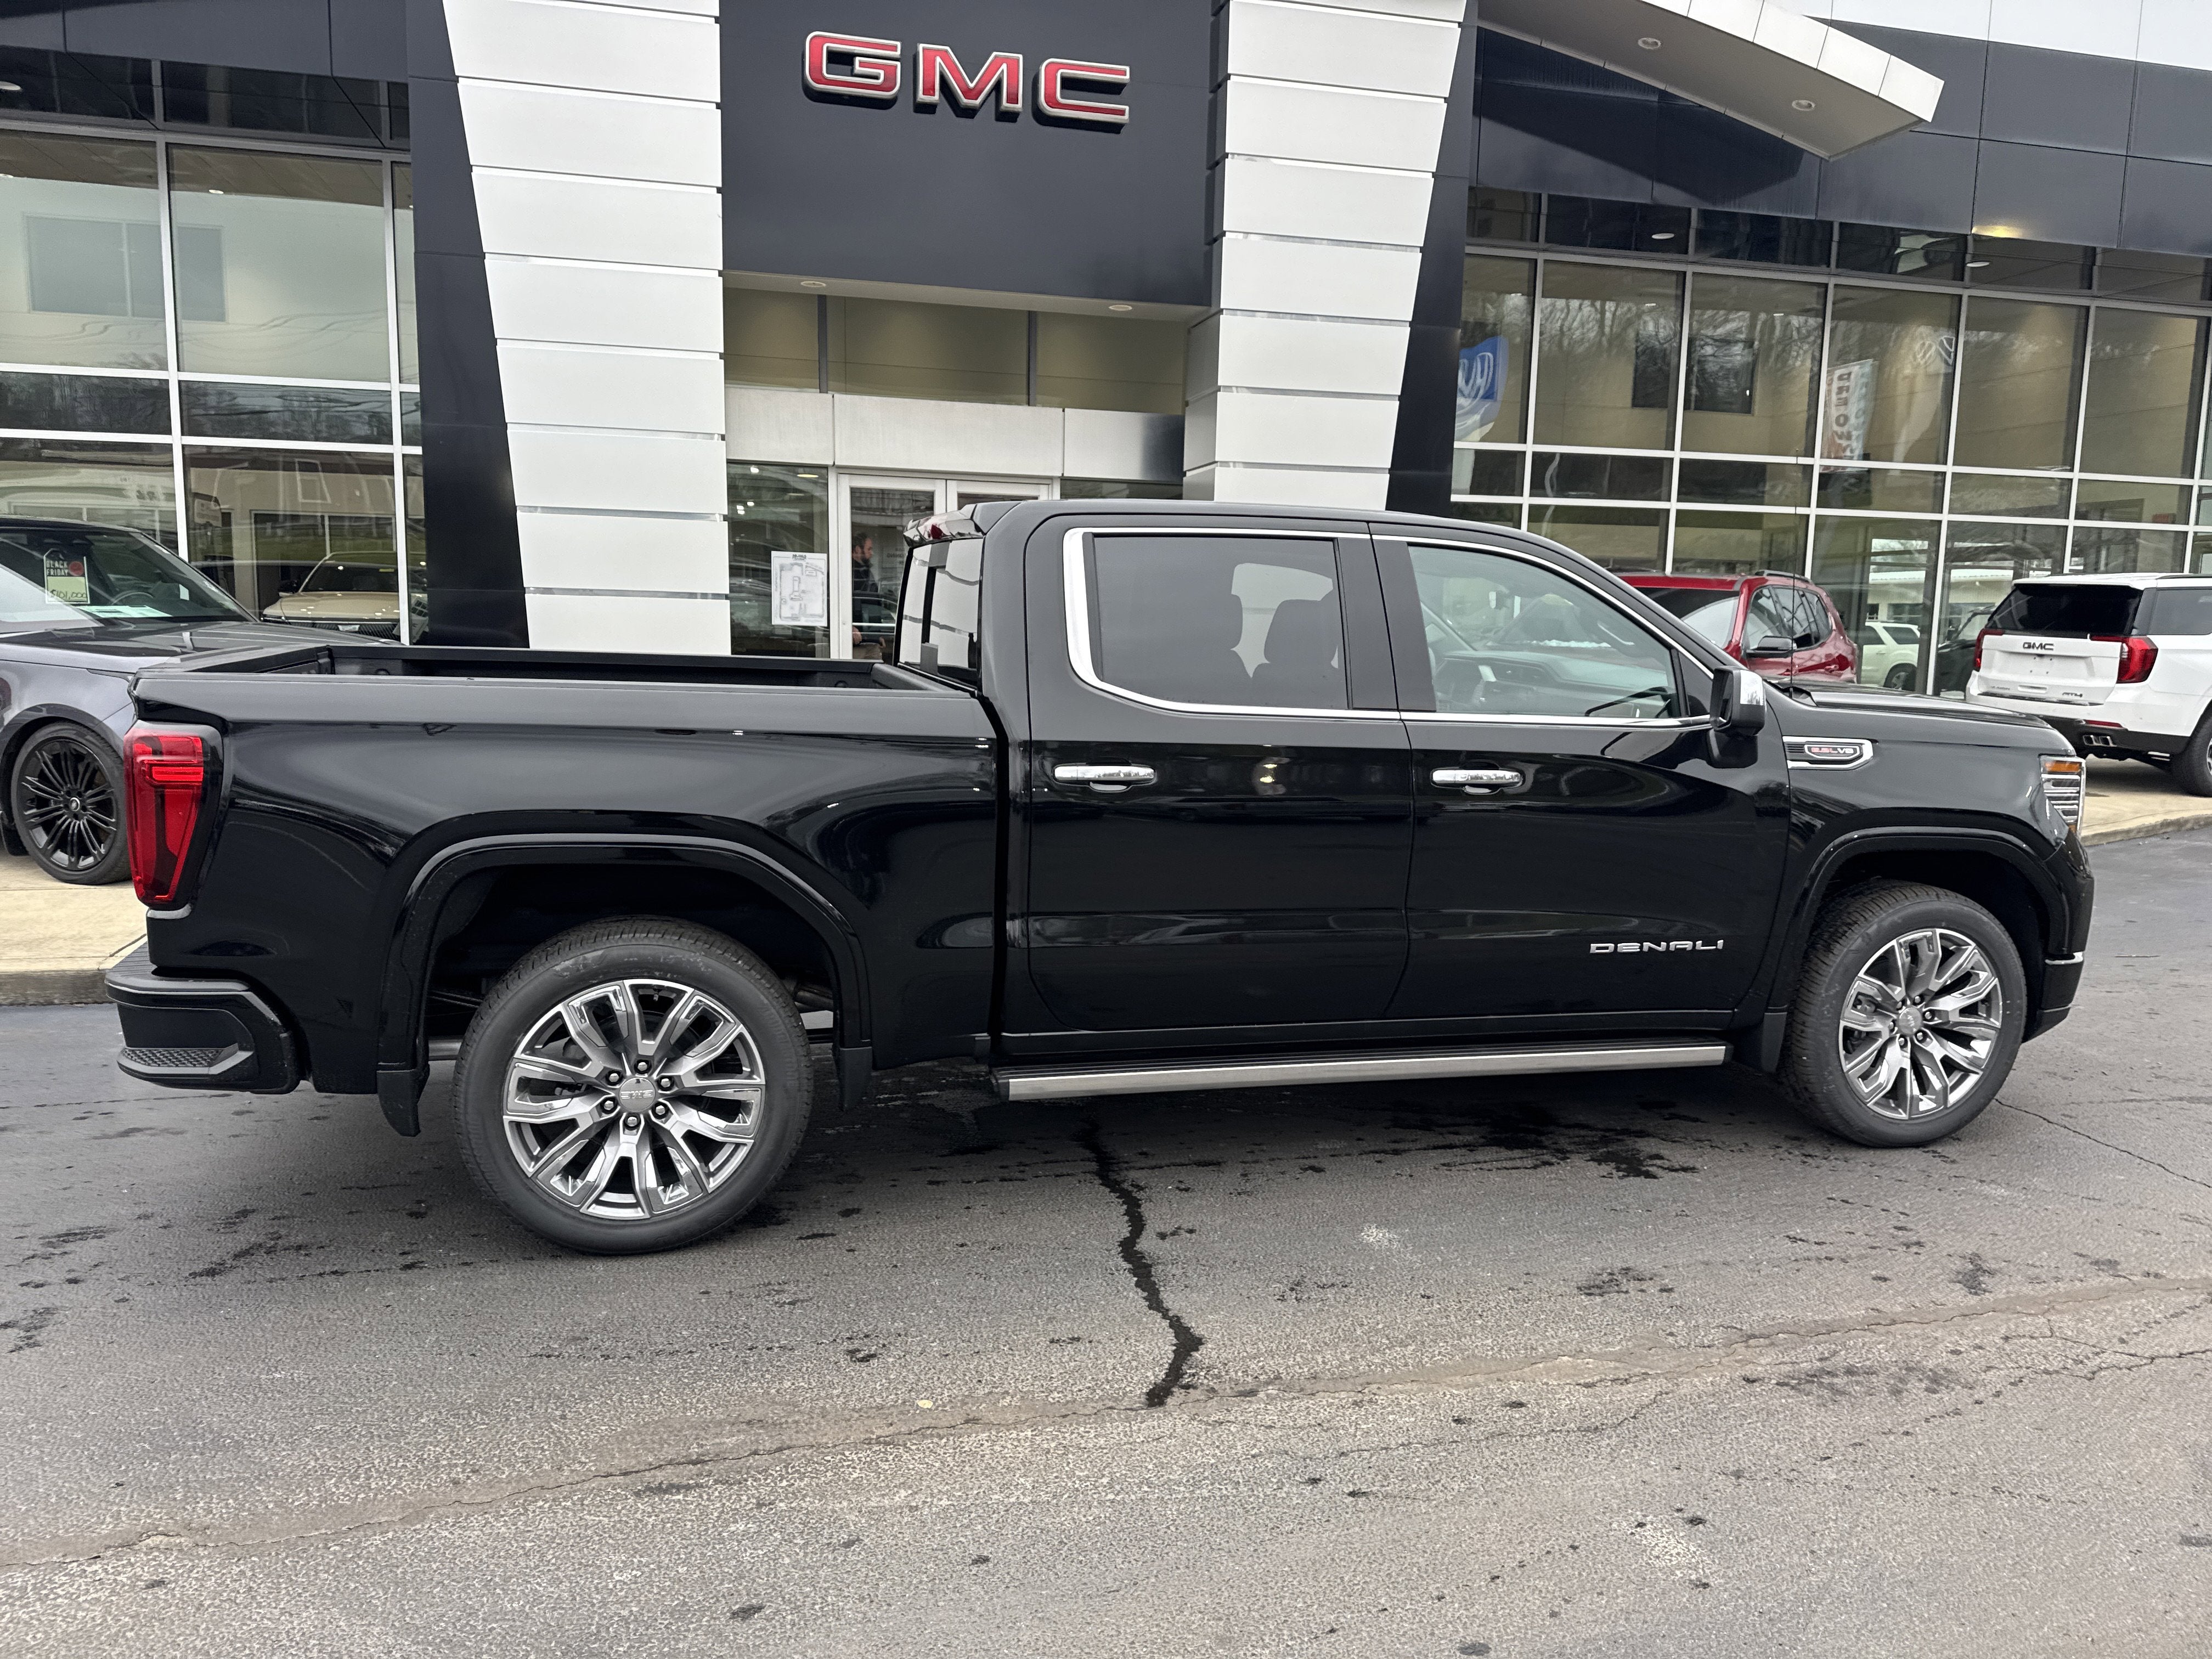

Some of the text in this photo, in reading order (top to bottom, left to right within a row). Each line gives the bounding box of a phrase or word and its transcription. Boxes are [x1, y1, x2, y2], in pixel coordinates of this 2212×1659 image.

[804, 31, 1130, 125] GMC
[2023, 642, 2054, 651] GMC
[1590, 940, 1724, 953] DENALI
